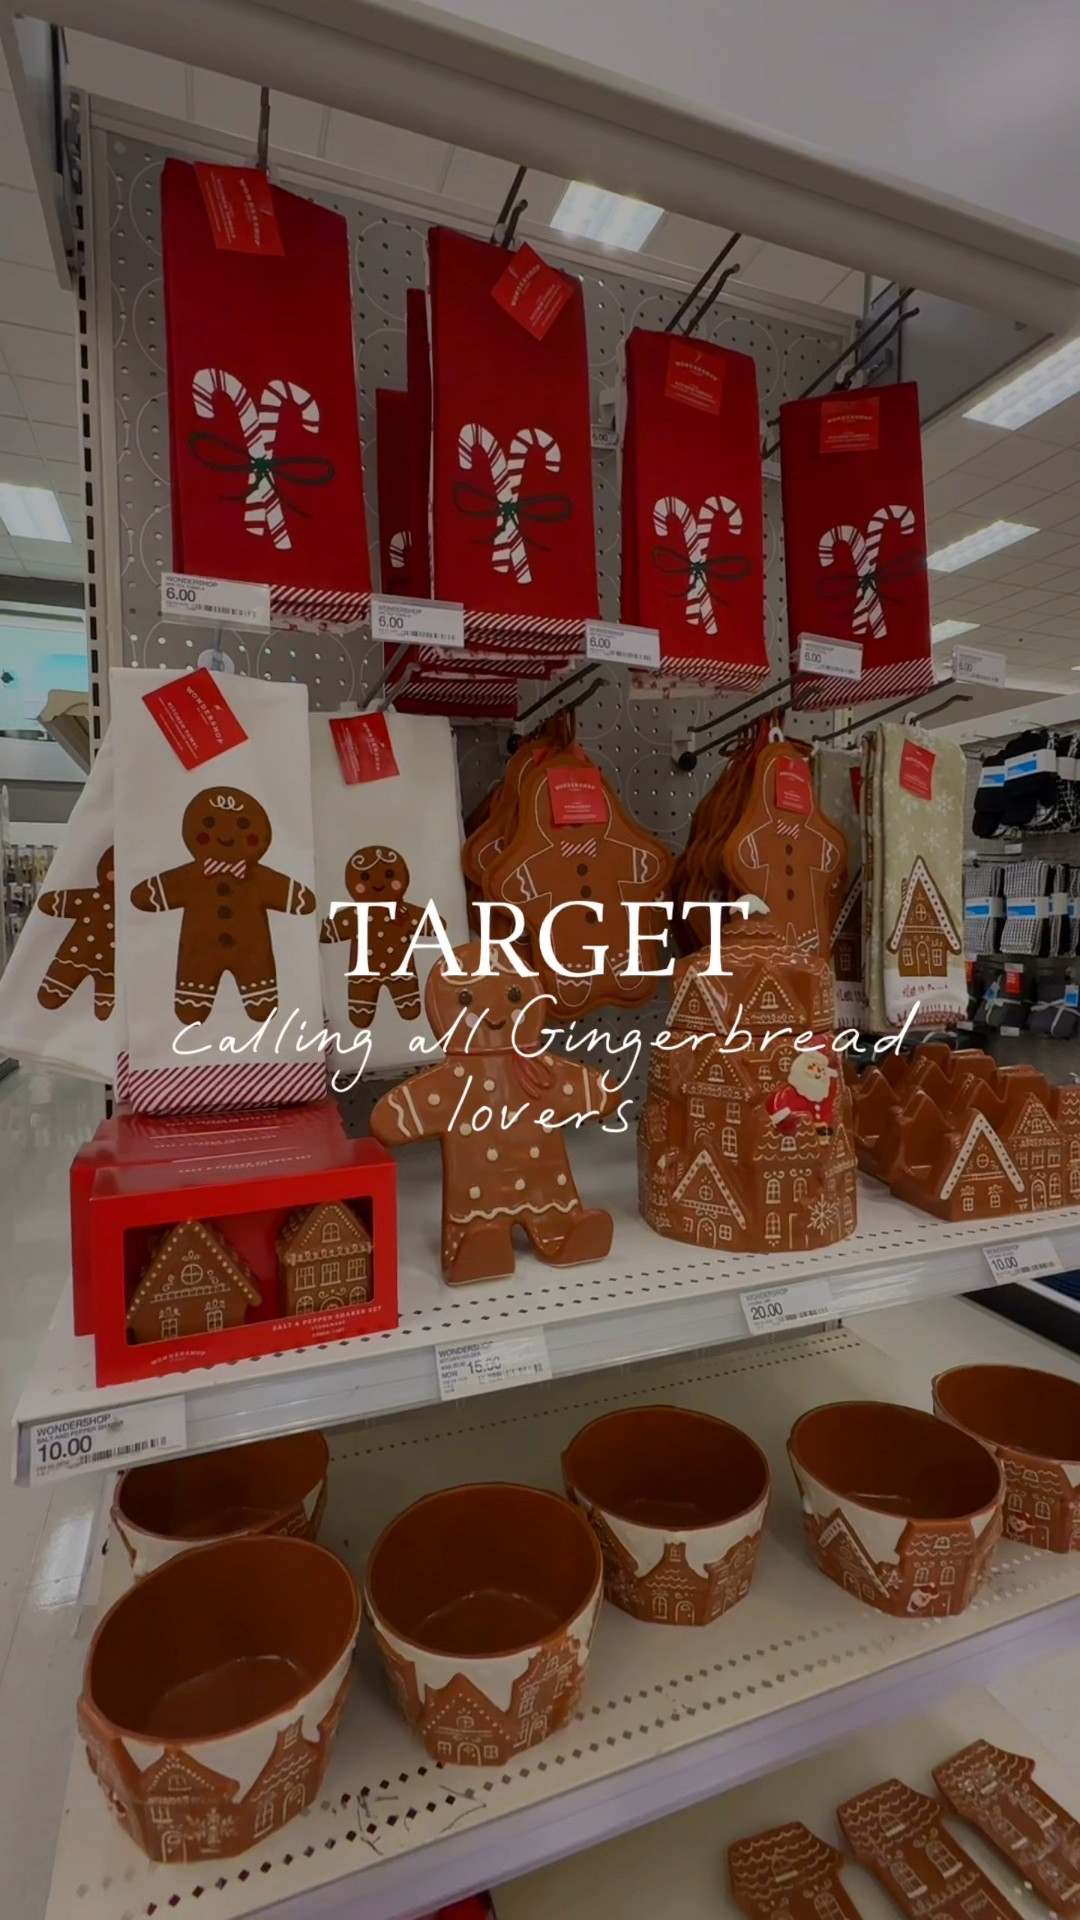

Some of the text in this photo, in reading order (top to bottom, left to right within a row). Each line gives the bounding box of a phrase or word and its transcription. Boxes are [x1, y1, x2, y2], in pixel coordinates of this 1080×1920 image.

[165, 576, 218, 588] WONDERSHOP
[166, 587, 197, 602] 6.00
[378, 615, 404, 629] 6.00
[589, 636, 611, 649] 6.00
[804, 651, 822, 664] 6.00
[186, 686, 223, 744] WONDERSHOP
[992, 1256, 1018, 1271] 10.00
[272, 1322, 293, 1331] SALT
[302, 1315, 333, 1325] PEPPER
[335, 1309, 366, 1319] SHAKER
[368, 1305, 382, 1313] SET
[750, 1302, 783, 1320] 20.00
[150, 1350, 206, 1366] WONDERSHOP
[467, 1356, 502, 1374] 15.00
[442, 1371, 458, 1379] NOW
[36, 1413, 112, 1437] WONDERSHOP
[36, 1435, 54, 1445] SALT
[54, 1432, 70, 1441] AND
[70, 1427, 97, 1438] PEPPER
[38, 1435, 92, 1462] 10.00
